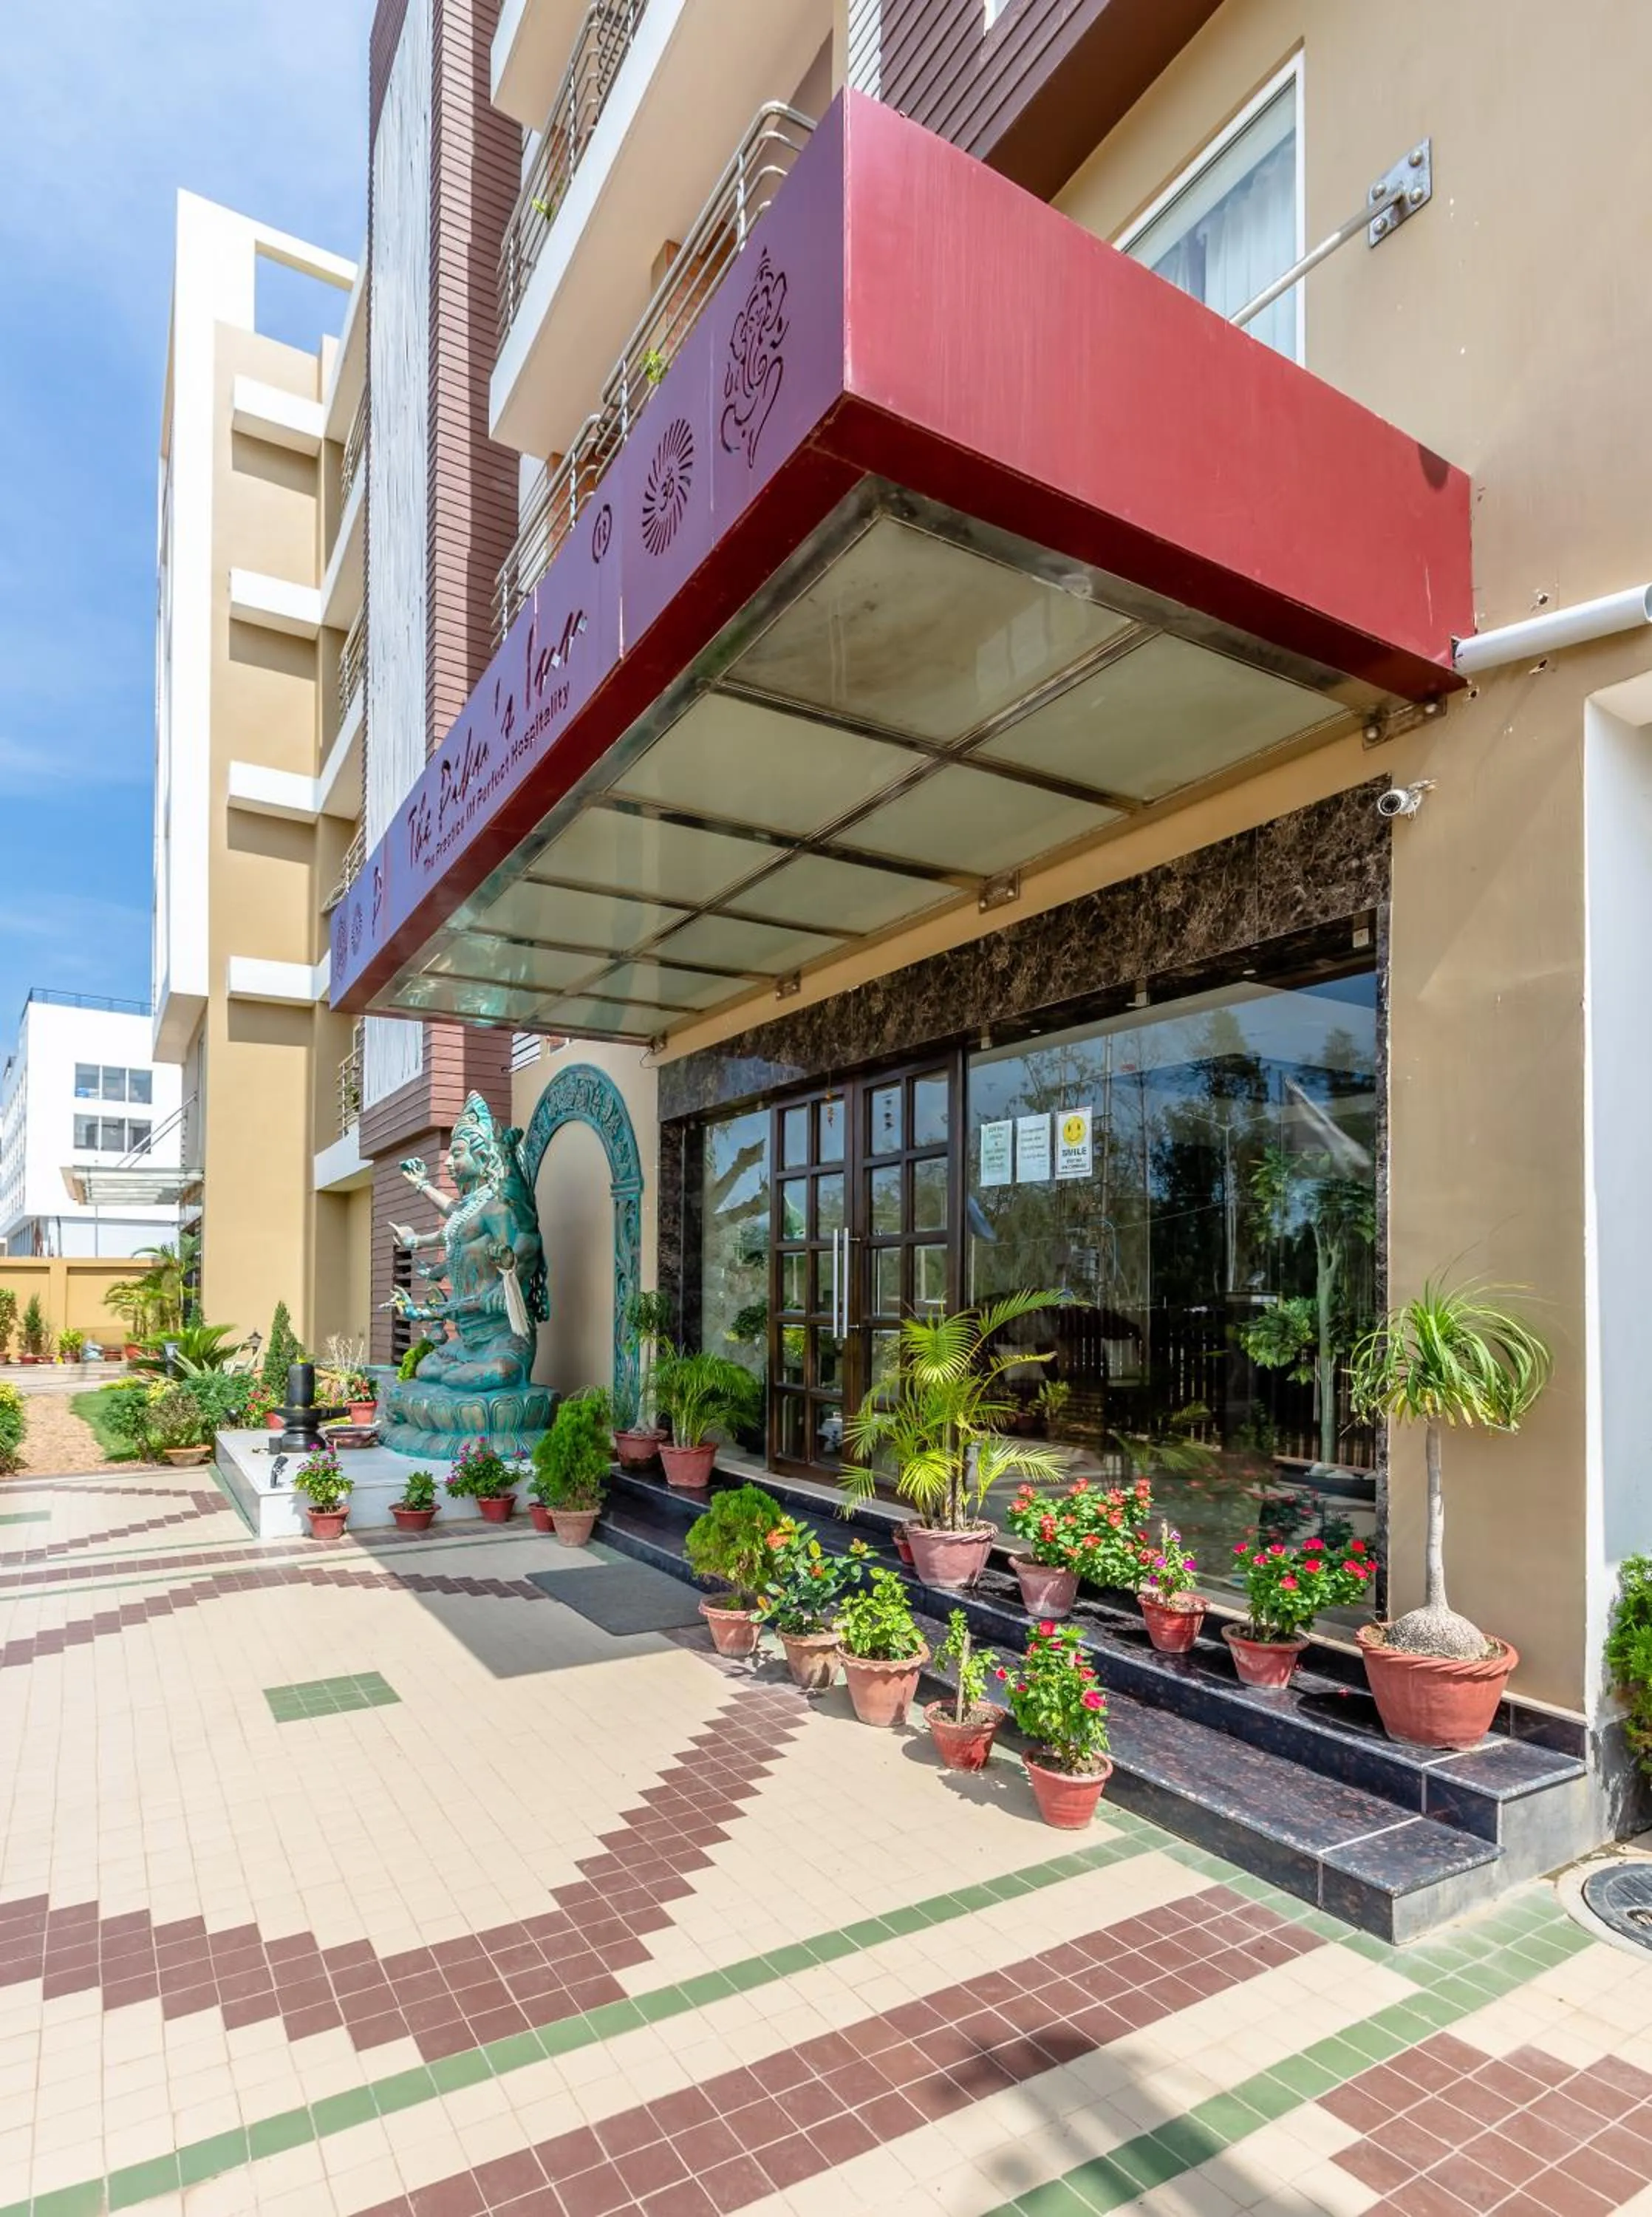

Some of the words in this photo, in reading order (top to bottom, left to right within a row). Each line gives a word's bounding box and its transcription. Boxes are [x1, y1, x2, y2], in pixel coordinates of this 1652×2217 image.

[407, 791, 431, 869] The
[525, 609, 587, 710] Inn
[423, 854, 434, 873] The
[436, 816, 465, 860] Practice
[466, 794, 477, 821] Of
[477, 756, 509, 808] Perfect
[511, 681, 570, 766] Hospitality
[1062, 1147, 1087, 1157] SMILE
